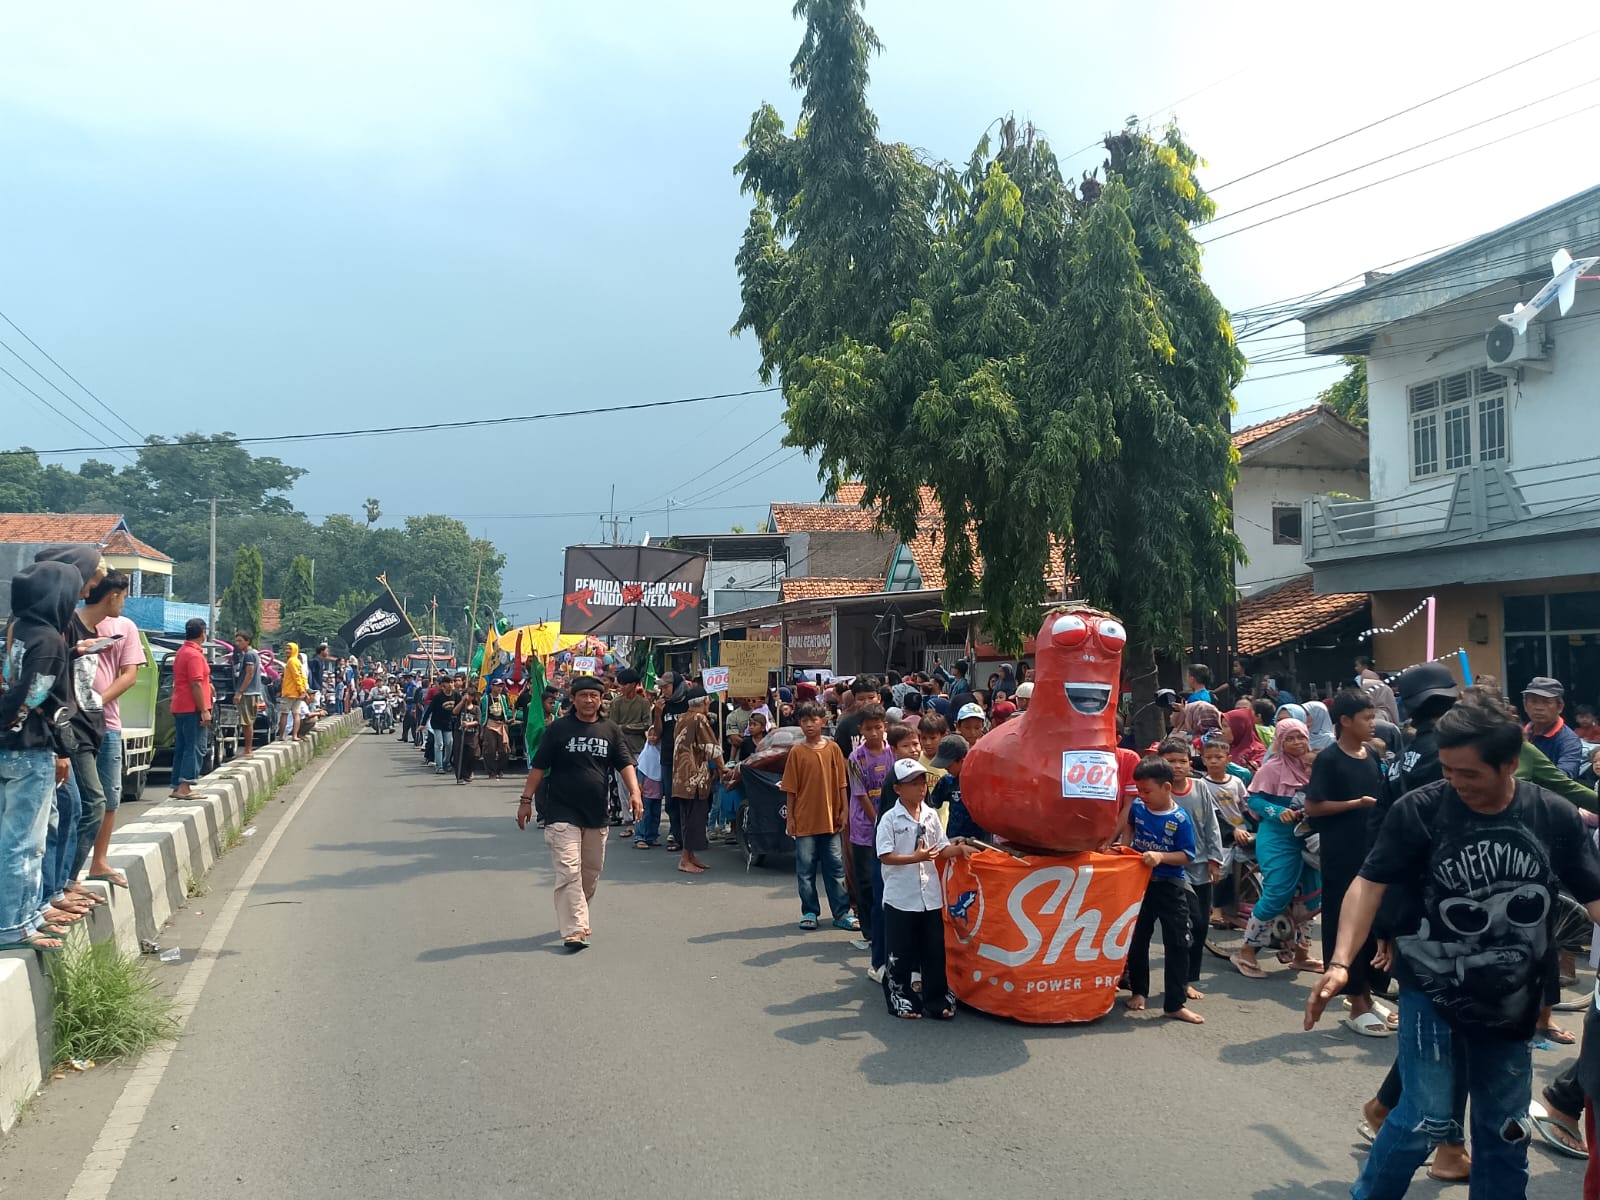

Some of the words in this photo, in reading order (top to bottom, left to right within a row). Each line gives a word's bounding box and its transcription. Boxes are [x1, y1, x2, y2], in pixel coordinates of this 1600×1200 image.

[575, 578, 620, 593] PEMUDA
[668, 582, 693, 594] KALI
[641, 594, 677, 607] WETAN
[1067, 764, 1116, 787] 007
[1433, 840, 1540, 897] NEVERMIND
[1026, 978, 1082, 993] POWER
